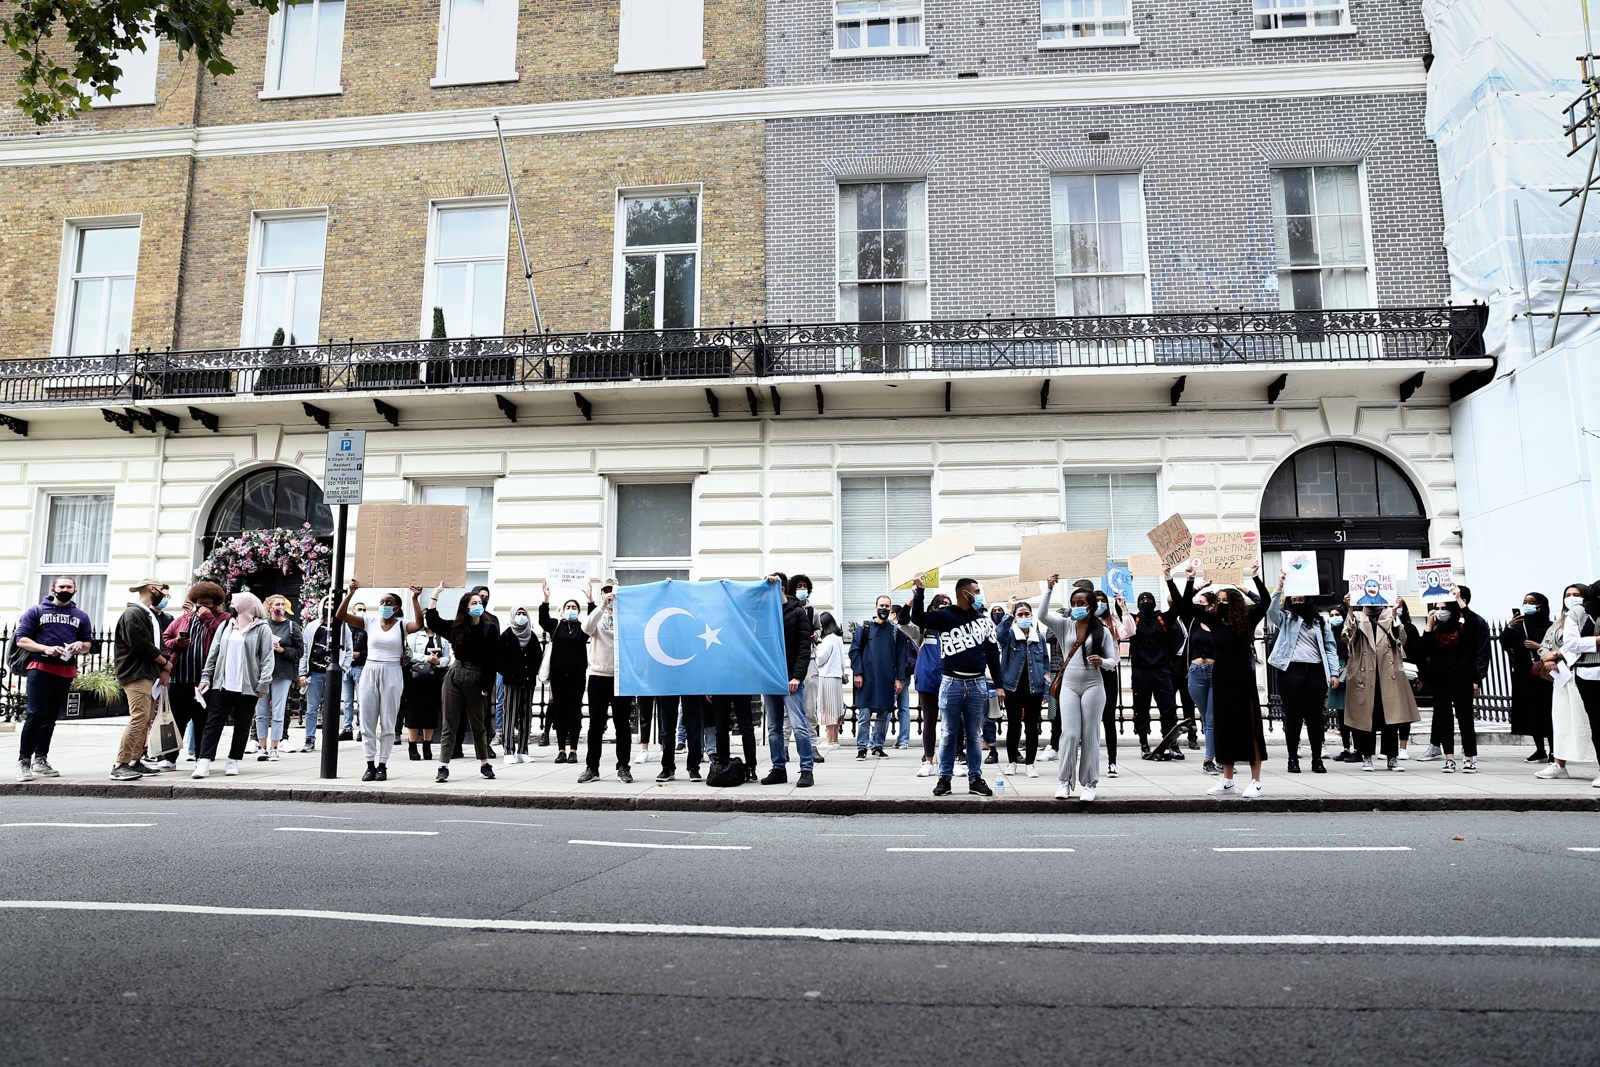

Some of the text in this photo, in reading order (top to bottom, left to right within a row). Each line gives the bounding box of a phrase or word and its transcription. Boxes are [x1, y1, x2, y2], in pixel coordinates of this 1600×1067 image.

[374, 510, 413, 526] FREE
[380, 528, 445, 541] FROM FORCED
[1208, 532, 1243, 544] CHINA
[1334, 530, 1347, 542] 31
[369, 541, 433, 556] LABOUR IN
[1224, 543, 1257, 553] ETHNIC
[1203, 553, 1252, 564] CLEANSING
[384, 558, 438, 577] CHINA
[1351, 574, 1391, 582] STOP THE
